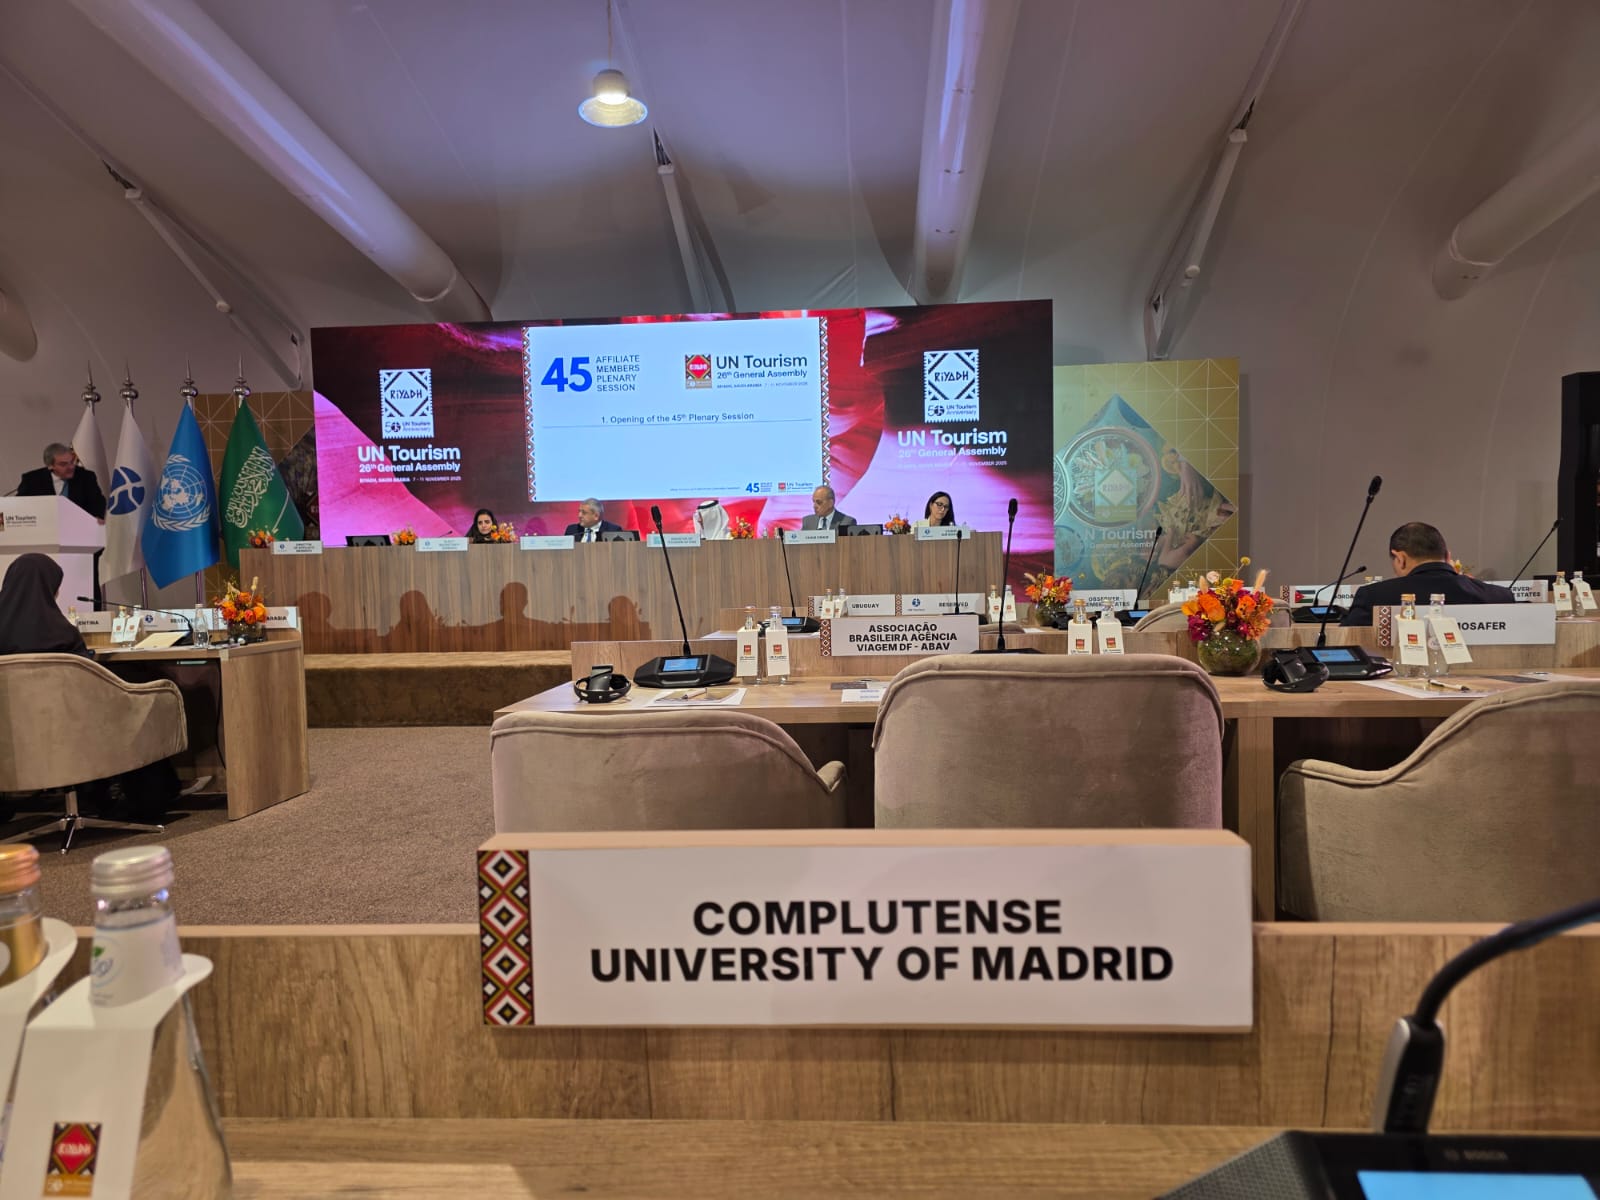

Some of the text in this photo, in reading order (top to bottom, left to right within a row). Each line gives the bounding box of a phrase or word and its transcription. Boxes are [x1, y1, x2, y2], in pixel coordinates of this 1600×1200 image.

[595, 355, 640, 364] AFFILIATE
[716, 356, 739, 369] UN
[743, 354, 807, 368] Tourism
[541, 356, 592, 392] 45
[596, 364, 640, 373] MEMBERS
[717, 369, 808, 379] 26th General Assembly
[596, 374, 637, 383] PLENARY
[596, 384, 635, 392] SESSION
[601, 412, 754, 424] 1. Opening of the 45th Plenary Session
[898, 428, 1007, 447] UN Tourism
[358, 444, 461, 462] UN Tourism
[918, 447, 957, 457] General
[958, 446, 1007, 457] Assembly
[359, 462, 461, 473] 26th General Assembly
[745, 483, 760, 493] 45
[869, 622, 938, 634] ASSOCIAÇÃO
[849, 631, 958, 643] BRASILEIRA AGÊNCIA
[857, 643, 898, 652] VIAGEM
[899, 643, 913, 651] DF
[921, 642, 950, 651] ABAV
[693, 900, 1062, 936] COMPLUTENSE
[591, 946, 1174, 982] UNIVERSITY OF MADRID
